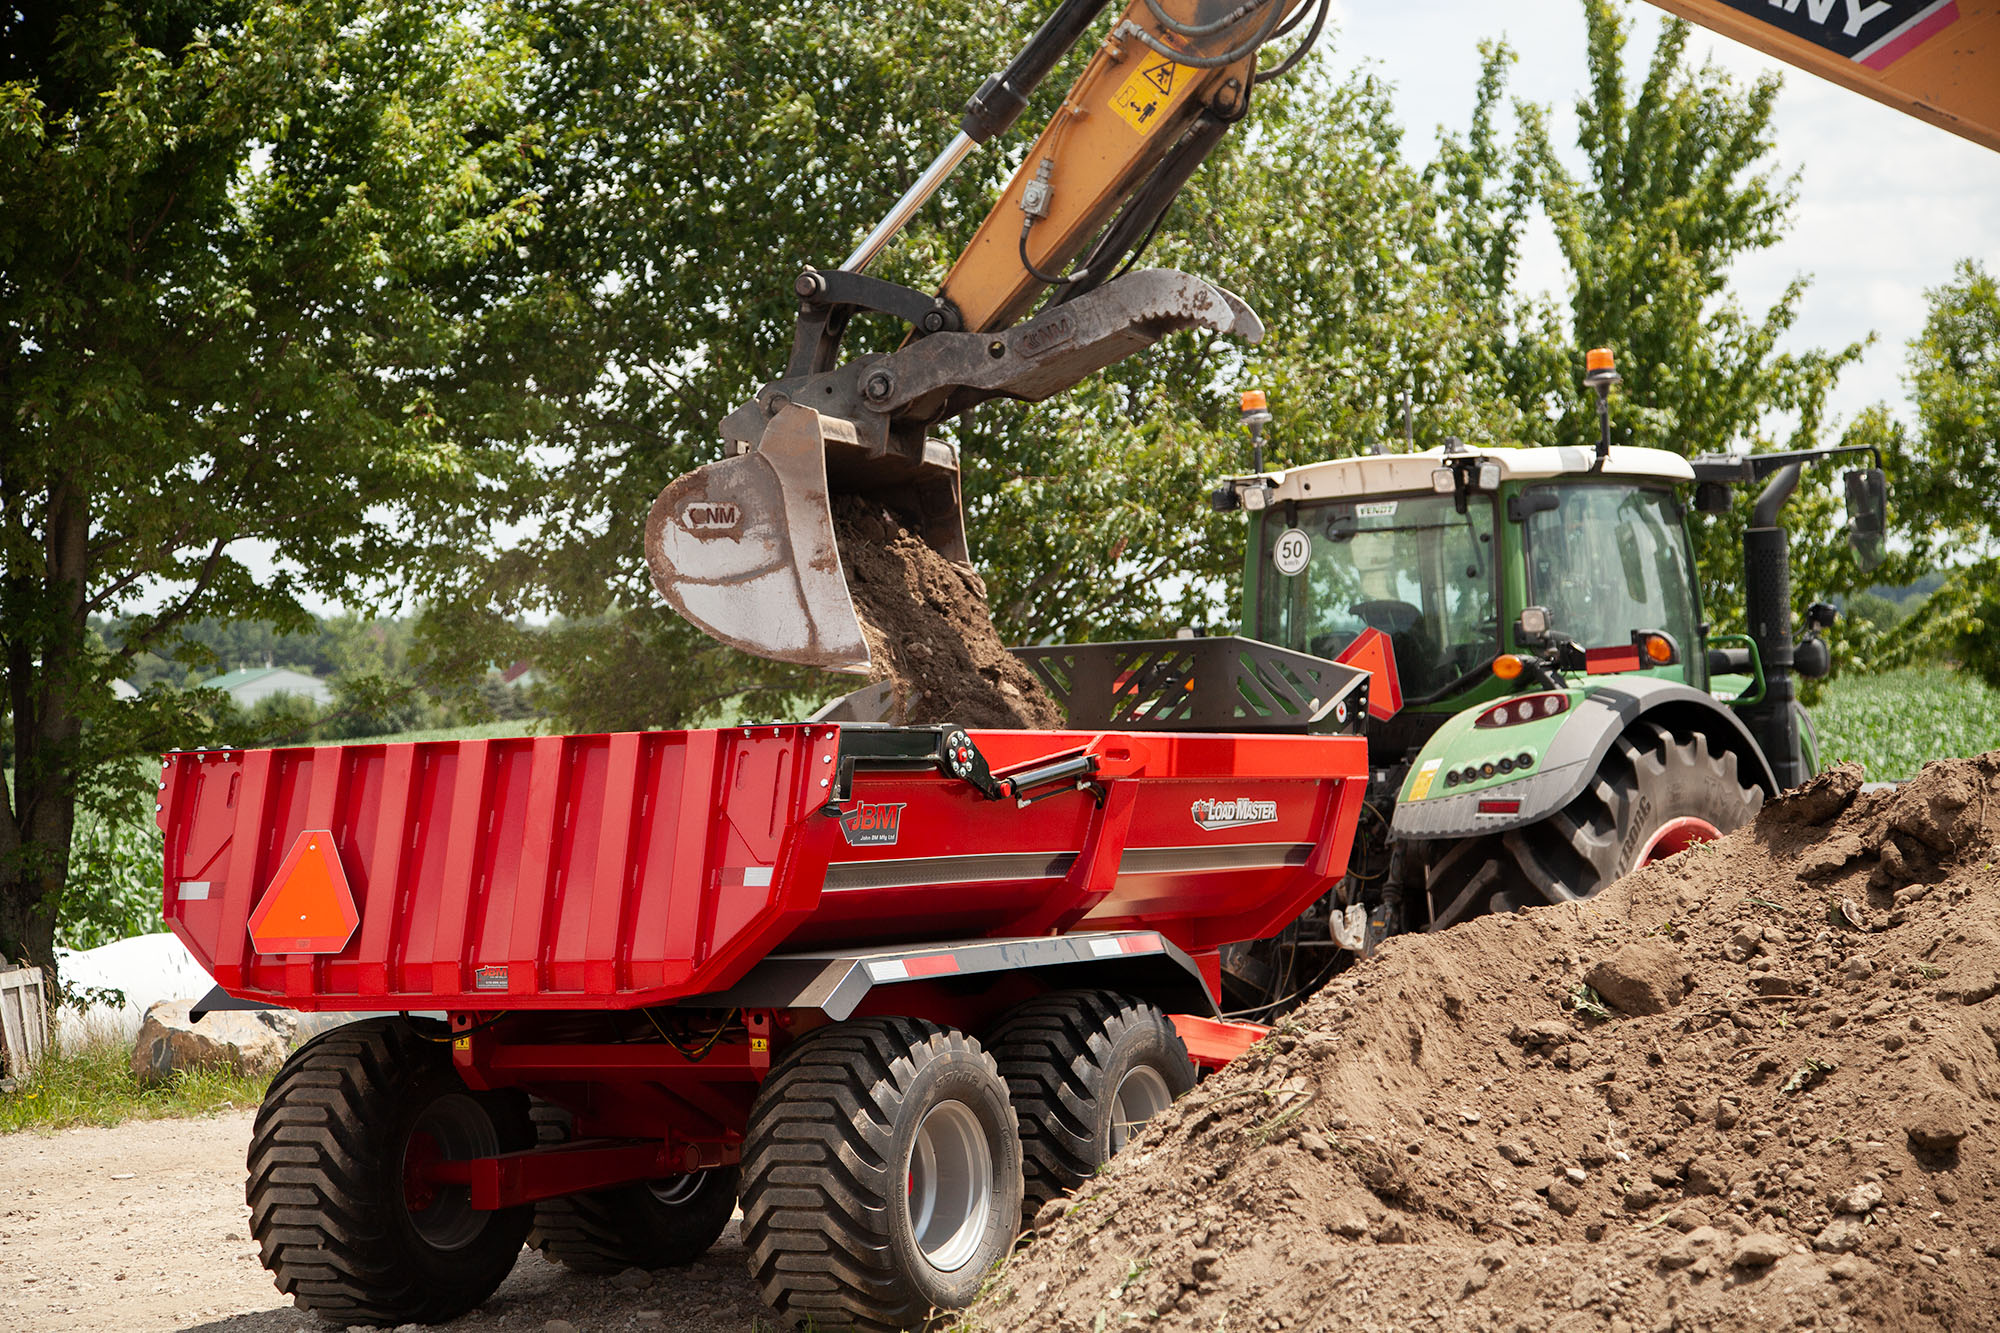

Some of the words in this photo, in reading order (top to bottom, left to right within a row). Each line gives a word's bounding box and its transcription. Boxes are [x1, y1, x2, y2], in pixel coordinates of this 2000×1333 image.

[1282, 540, 1303, 559] 50
[852, 802, 898, 831] JBM
[1208, 800, 1236, 821] LOAD
[1236, 799, 1276, 820] MASTER
[483, 967, 507, 977] JBM
